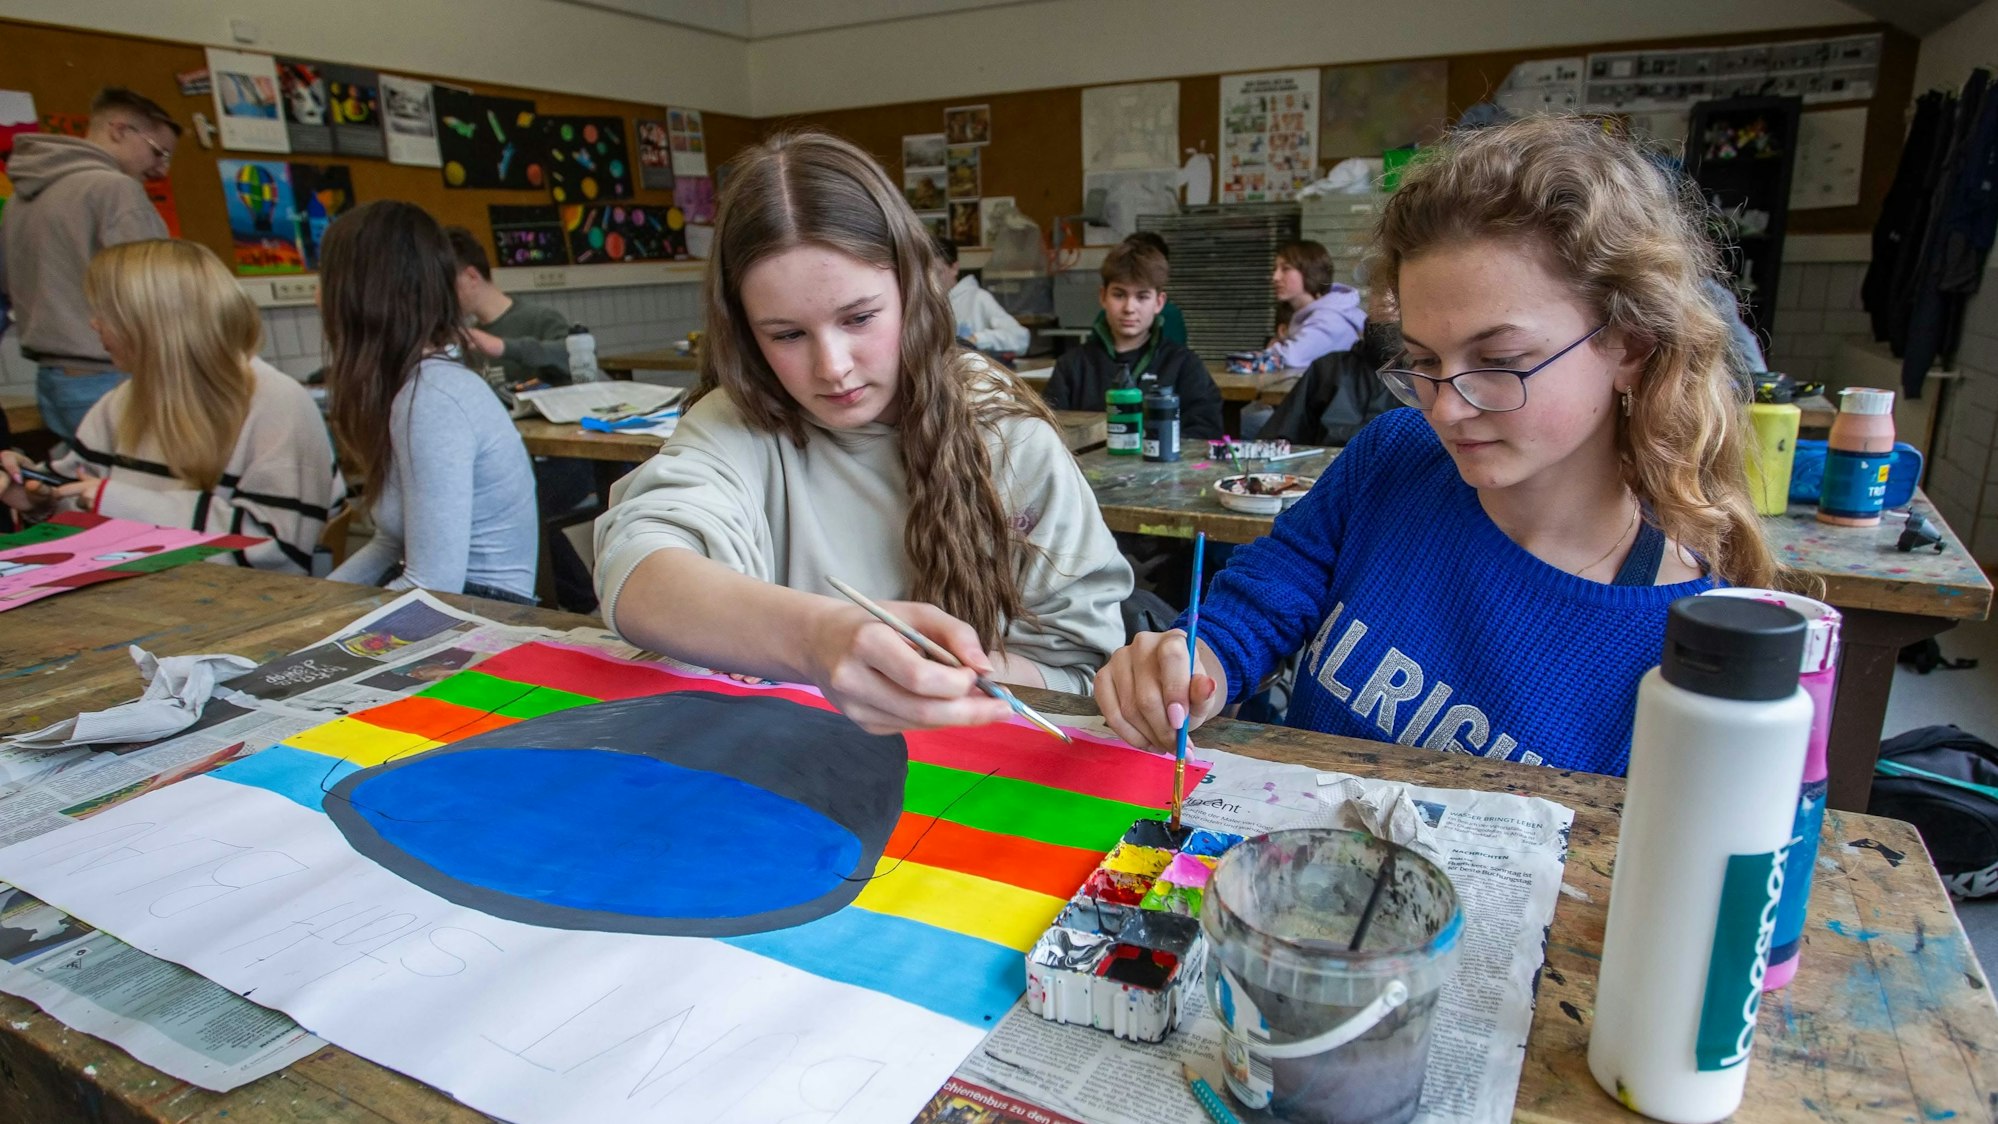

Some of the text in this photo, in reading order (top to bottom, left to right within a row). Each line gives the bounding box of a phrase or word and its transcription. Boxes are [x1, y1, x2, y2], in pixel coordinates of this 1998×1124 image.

[1303, 601, 1555, 770] ALRIG
[1186, 796, 1242, 813] incent
[1450, 811, 1544, 829] WASSER BRINGT LEBEN
[1452, 849, 1510, 860] NACHRICHTEN
[1459, 866, 1481, 874] beste
[1481, 870, 1533, 886] Buchungstag
[1490, 866, 1522, 878] Sonntag
[943, 1081, 1009, 1110] chienenbus
[1009, 1104, 1026, 1116] zu
[1026, 1109, 1051, 1124] den
